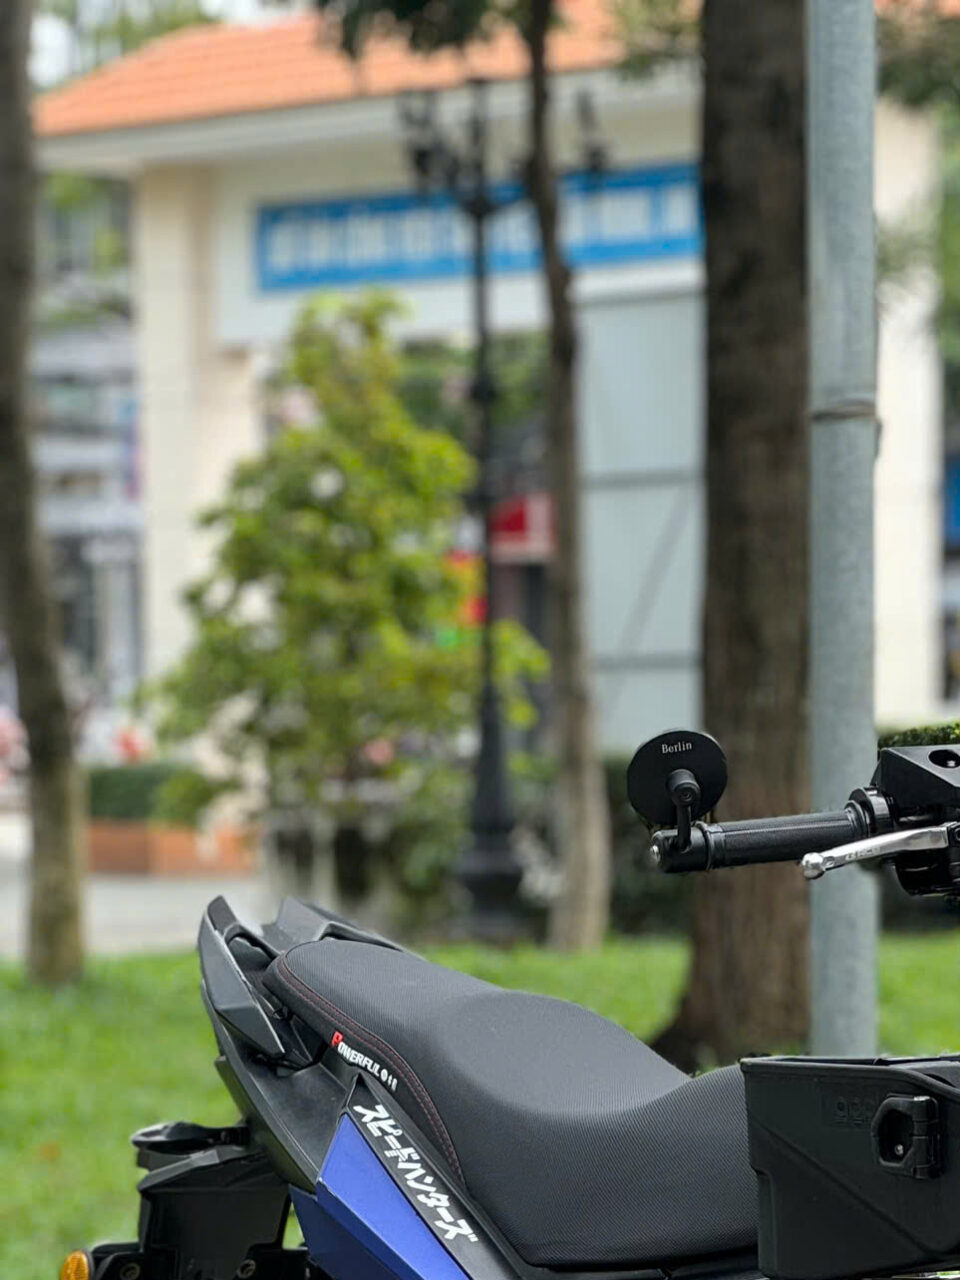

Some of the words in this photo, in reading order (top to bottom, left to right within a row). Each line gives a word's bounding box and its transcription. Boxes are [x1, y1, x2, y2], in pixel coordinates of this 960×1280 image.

[661, 740, 692, 755] Berlin
[331, 1031, 381, 1077] POWERFUL
[353, 1104, 479, 1242] スピードハンターズ
